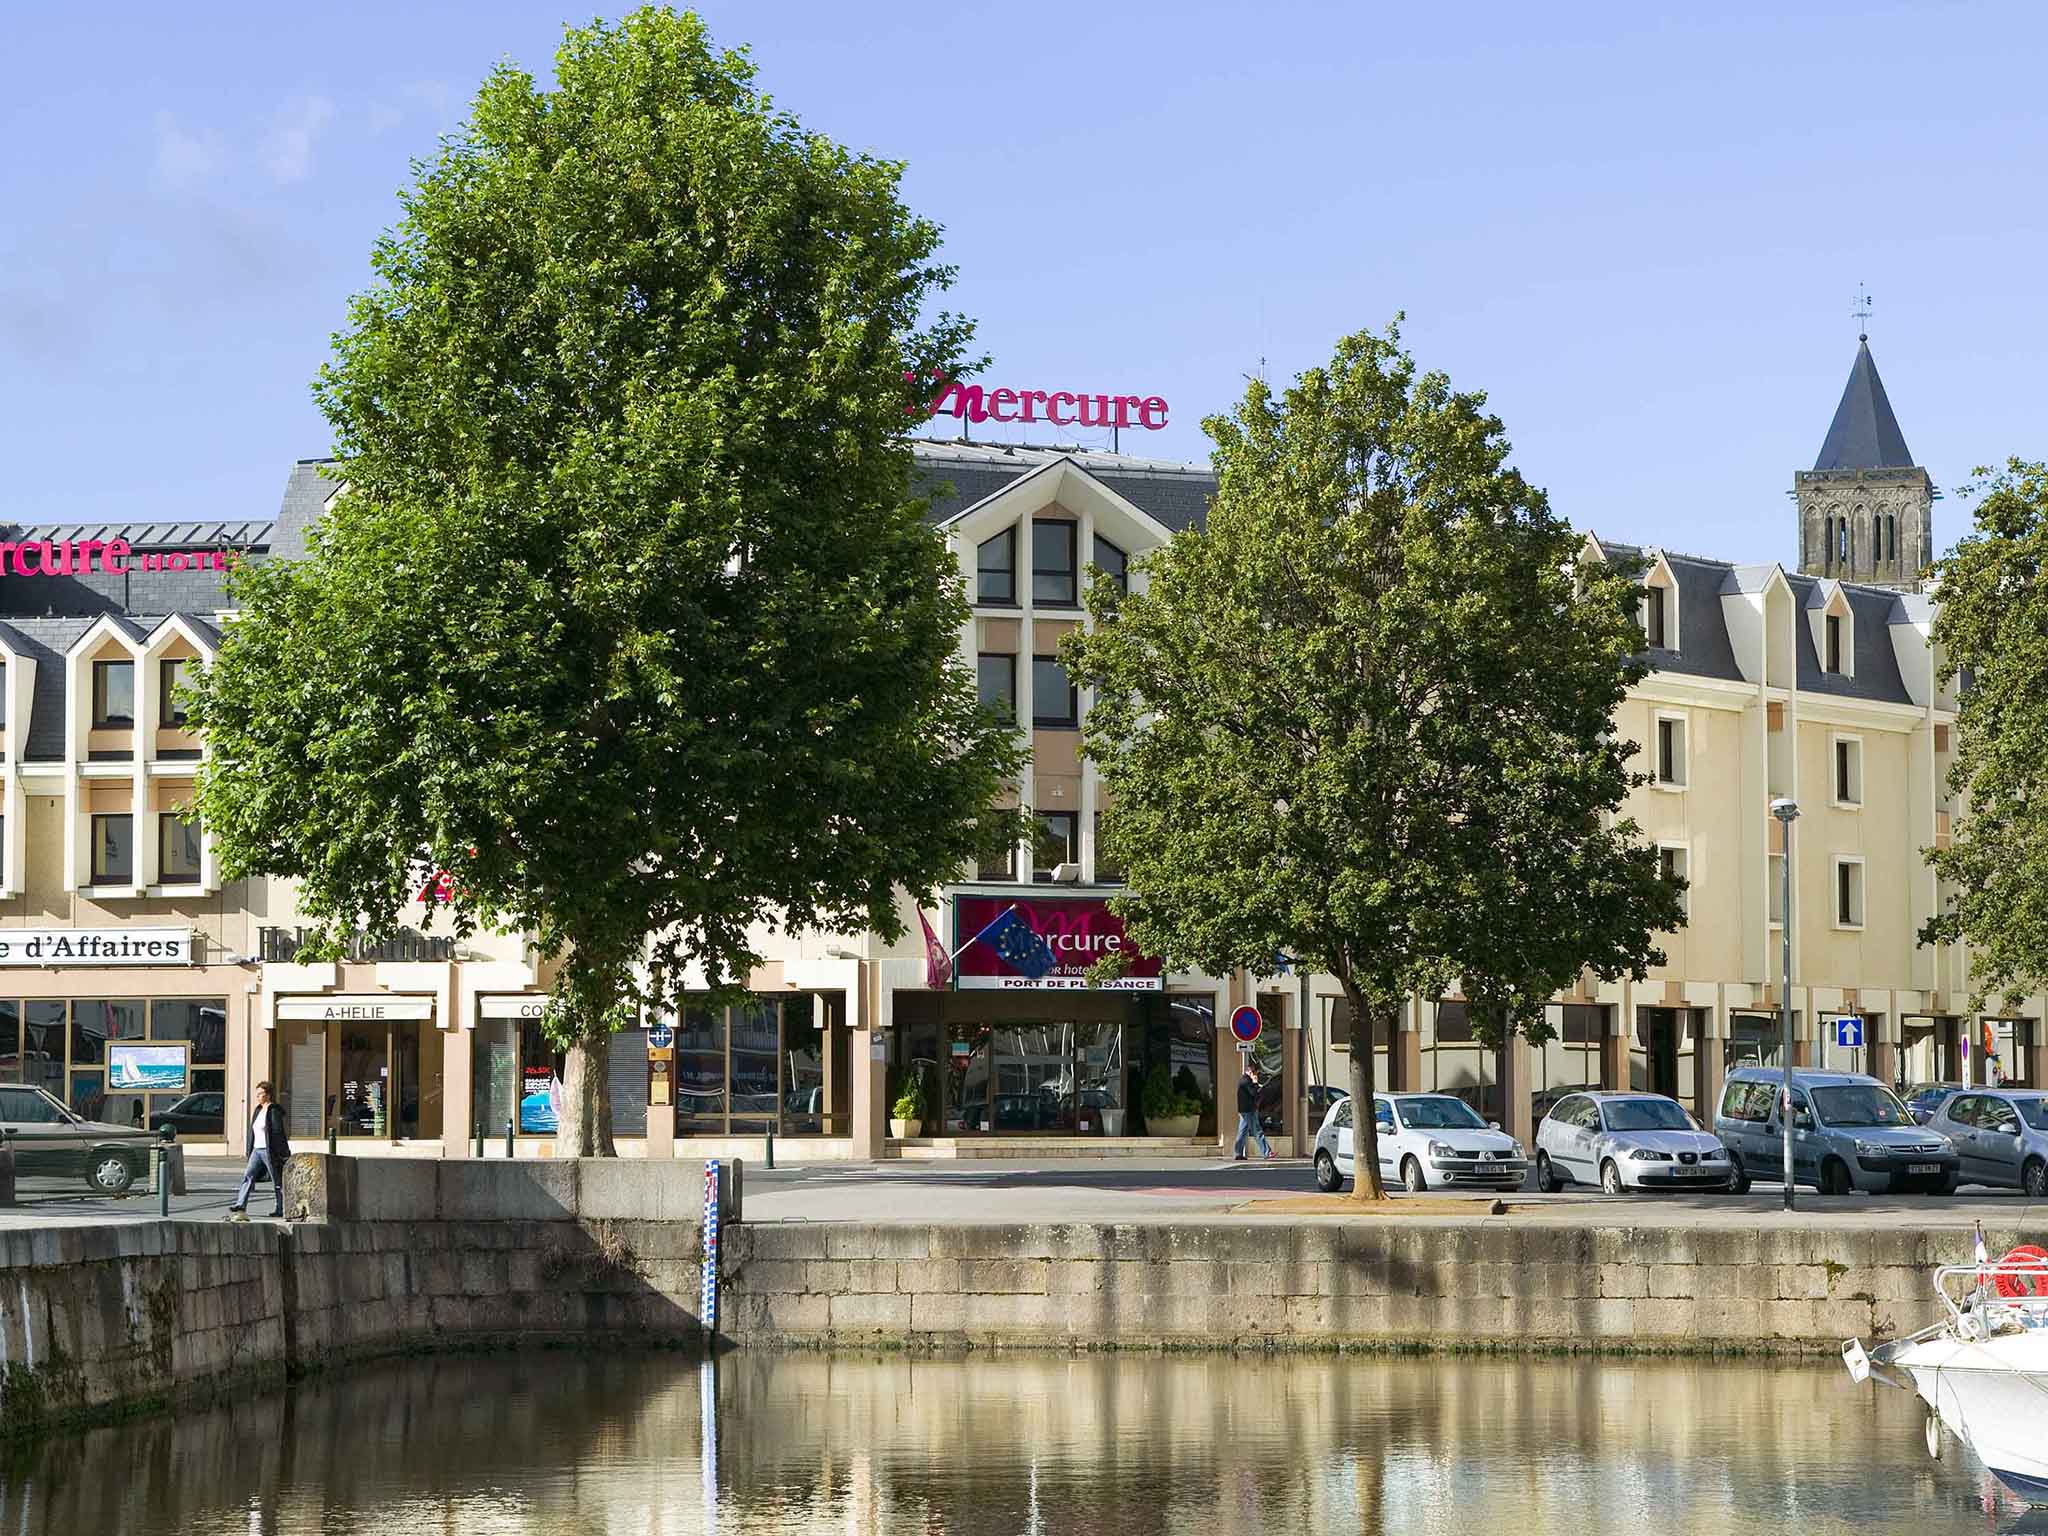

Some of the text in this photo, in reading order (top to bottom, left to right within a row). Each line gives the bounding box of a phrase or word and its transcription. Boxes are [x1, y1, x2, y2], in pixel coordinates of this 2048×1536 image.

[142, 551, 229, 573] HOTE
[25, 936, 180, 958] d'Affaires
[1036, 932, 1122, 952] rcure
[1004, 980, 1155, 989] PORT DE PLISANCE
[324, 1006, 385, 1019] A-HELIE
